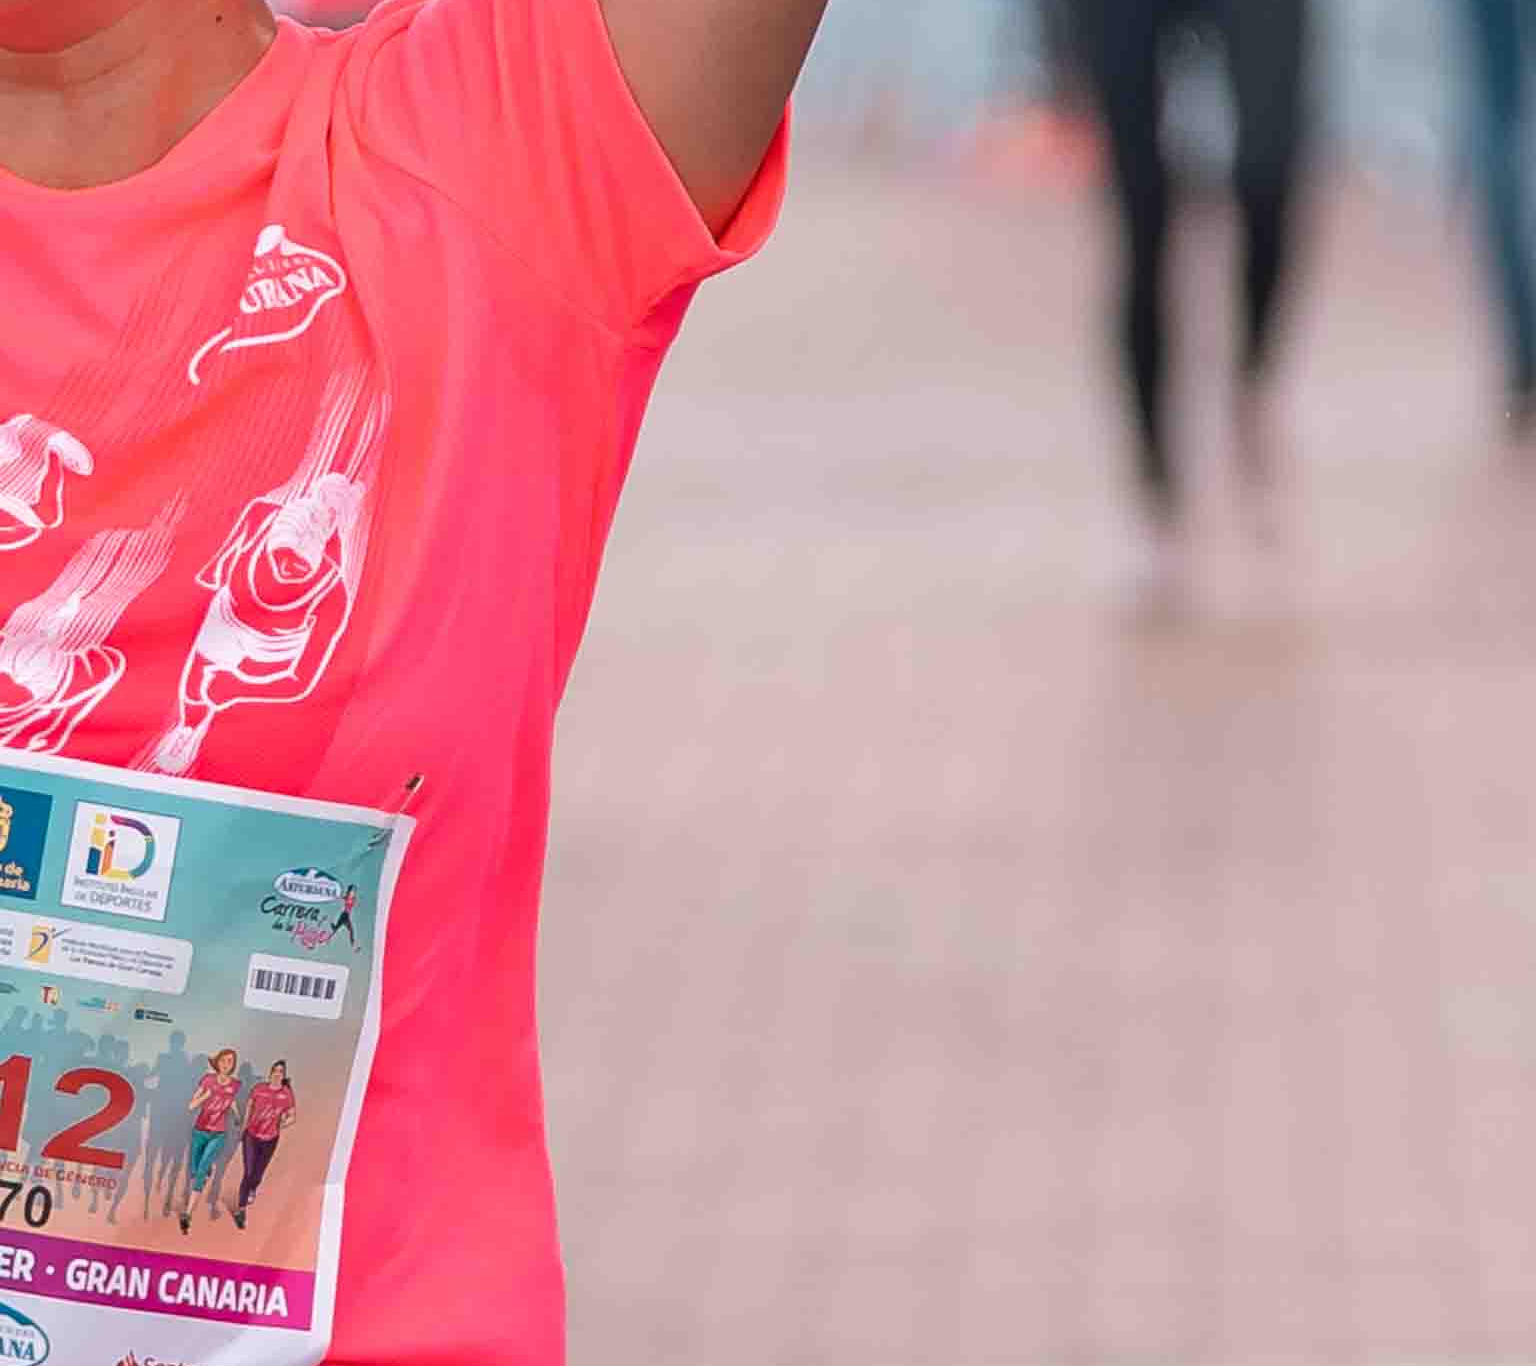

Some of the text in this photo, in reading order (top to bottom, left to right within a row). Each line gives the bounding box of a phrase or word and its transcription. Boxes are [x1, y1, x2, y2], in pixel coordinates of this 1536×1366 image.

[4, 861, 24, 876] de
[65, 1257, 151, 1300] GRAN
[158, 1270, 289, 1318] CANARIA
